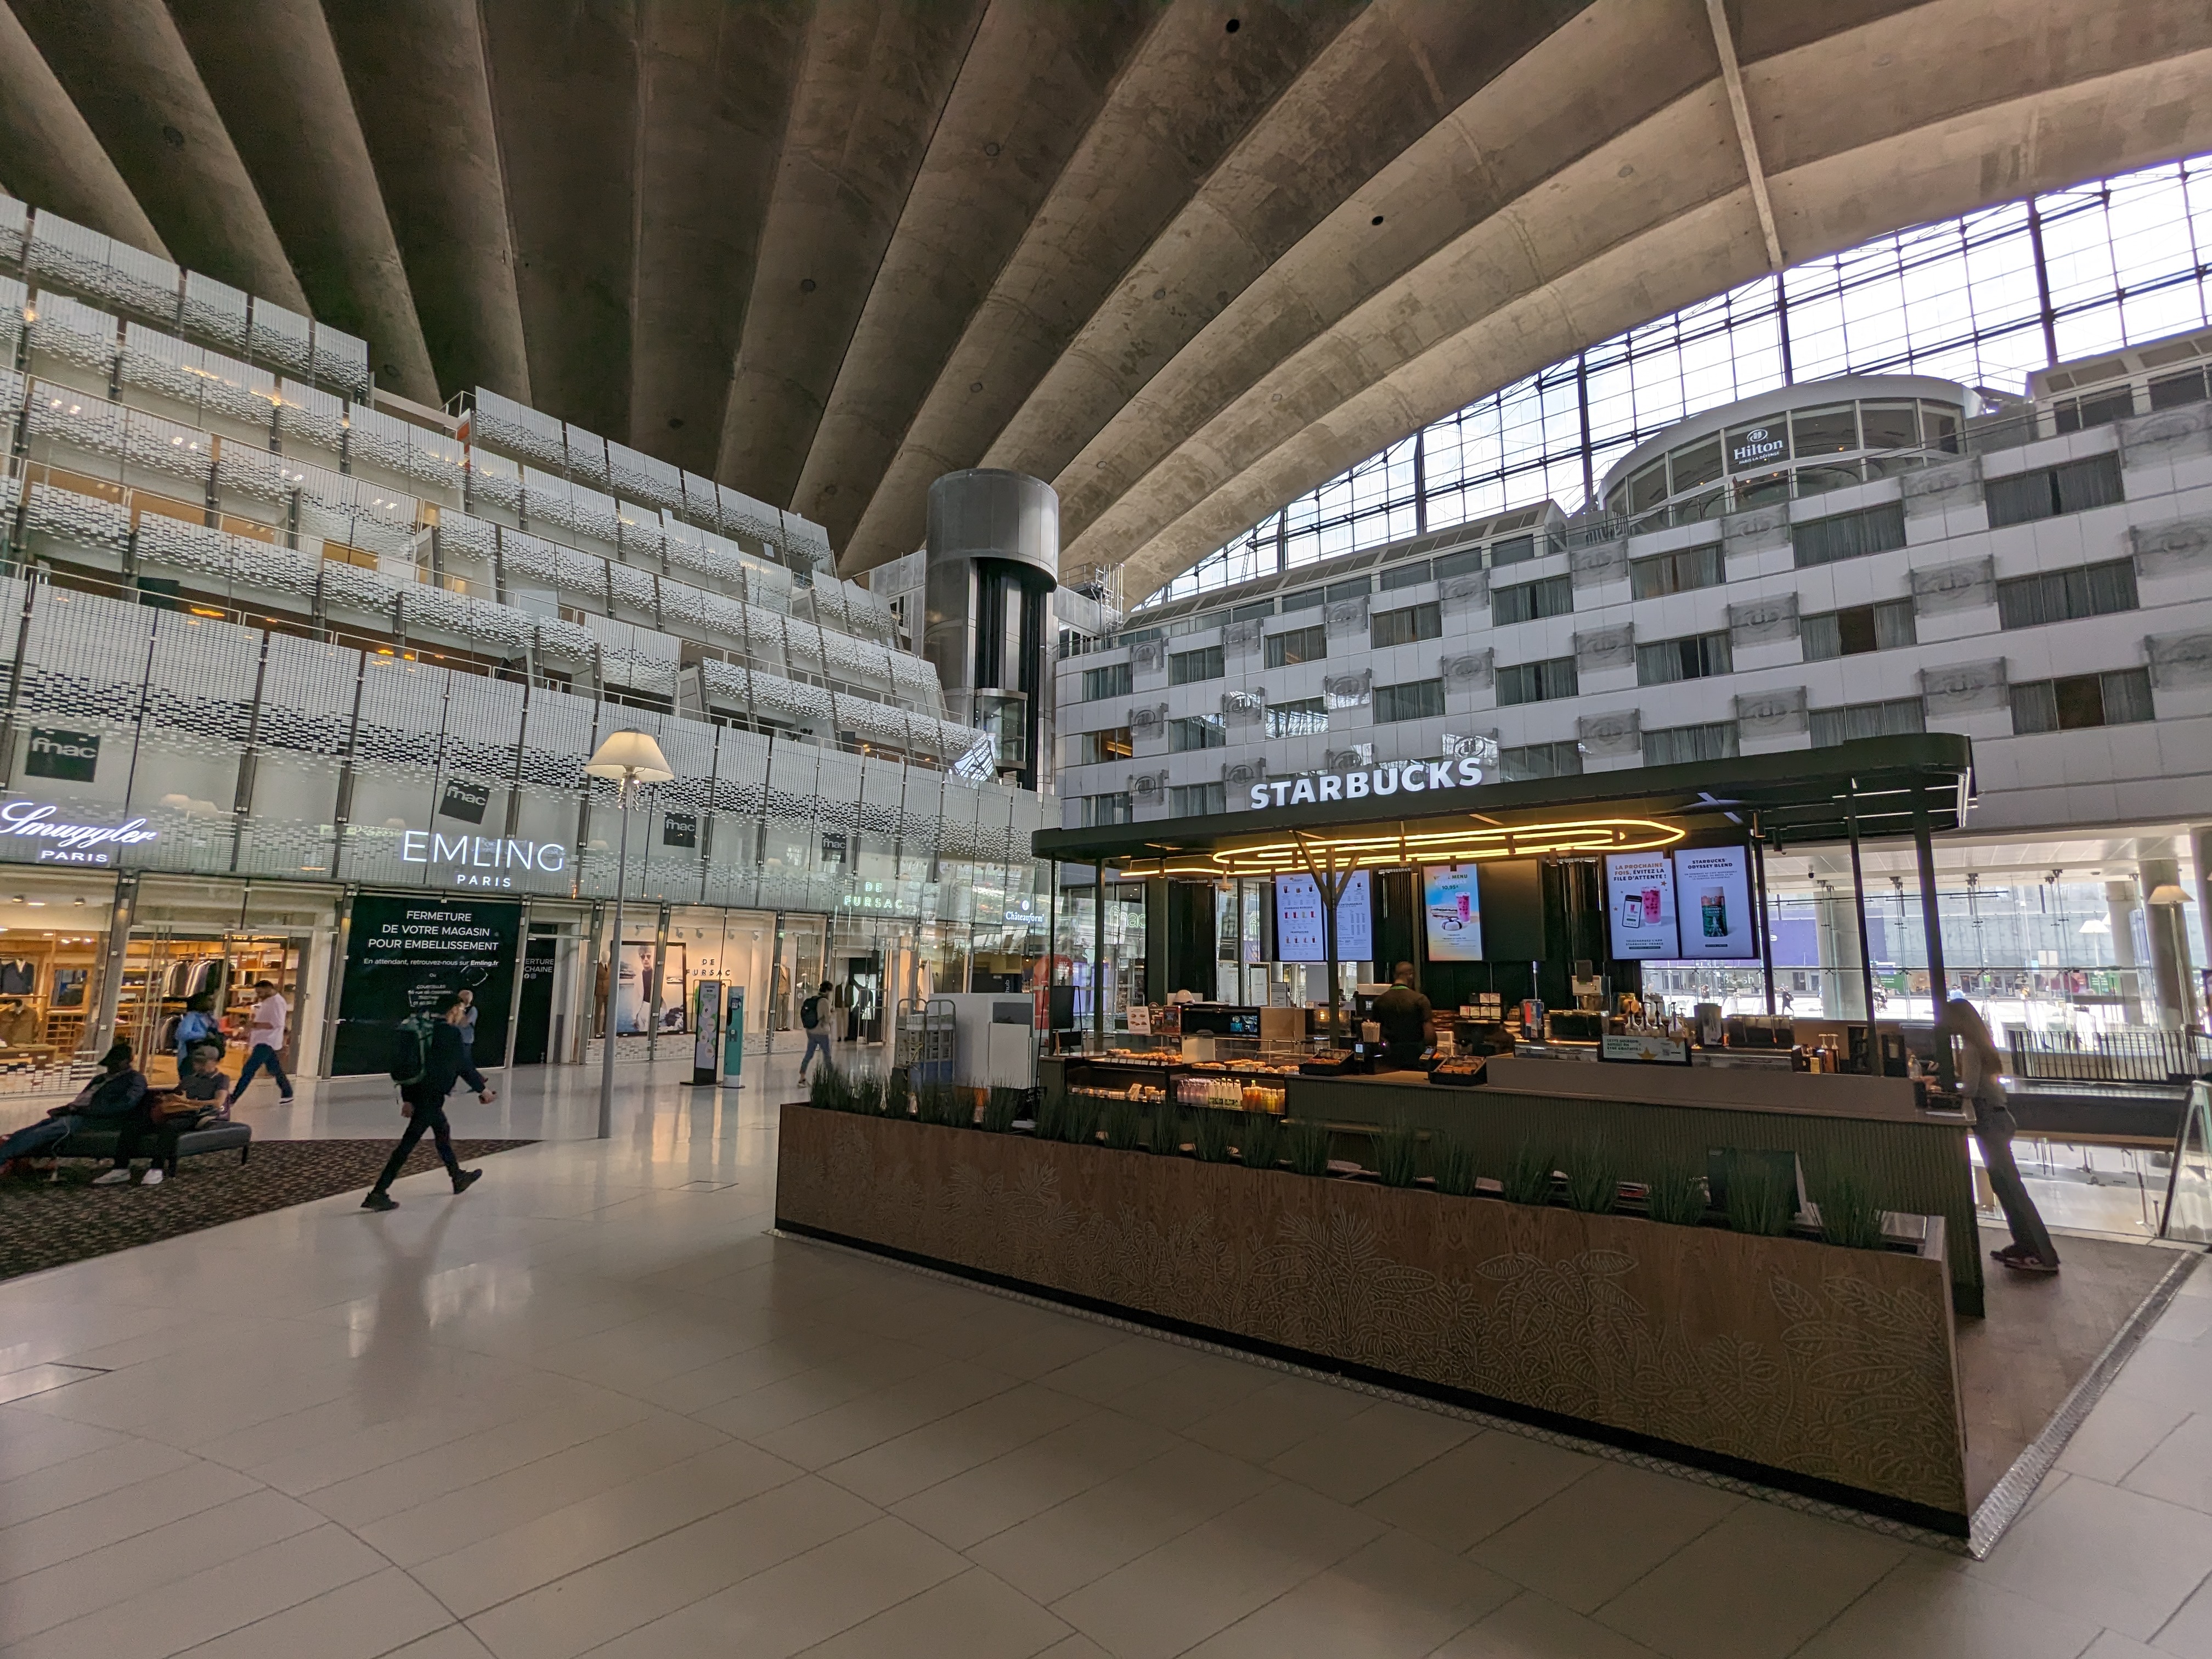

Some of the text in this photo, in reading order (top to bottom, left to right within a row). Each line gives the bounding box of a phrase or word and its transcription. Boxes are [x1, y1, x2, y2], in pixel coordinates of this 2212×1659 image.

[1734, 440, 1783, 460] Hilton
[31, 737, 98, 759] fnac
[1251, 757, 1484, 810] STARBUCKS
[446, 786, 486, 805] fnac
[0, 802, 157, 848] Smuggler
[665, 818, 696, 832] fnac
[403, 830, 565, 871] EMLING
[823, 838, 847, 849] fnac
[41, 850, 108, 862] PARIS
[457, 874, 511, 887] PARIS
[865, 882, 883, 892] DE
[844, 895, 903, 909] FURSAC
[407, 911, 472, 922] FERMETURE
[1109, 905, 1146, 928] fnac
[382, 924, 490, 936] DE VOTRE MAGASIN
[368, 939, 499, 950] POUR EMBELLISSEMENT
